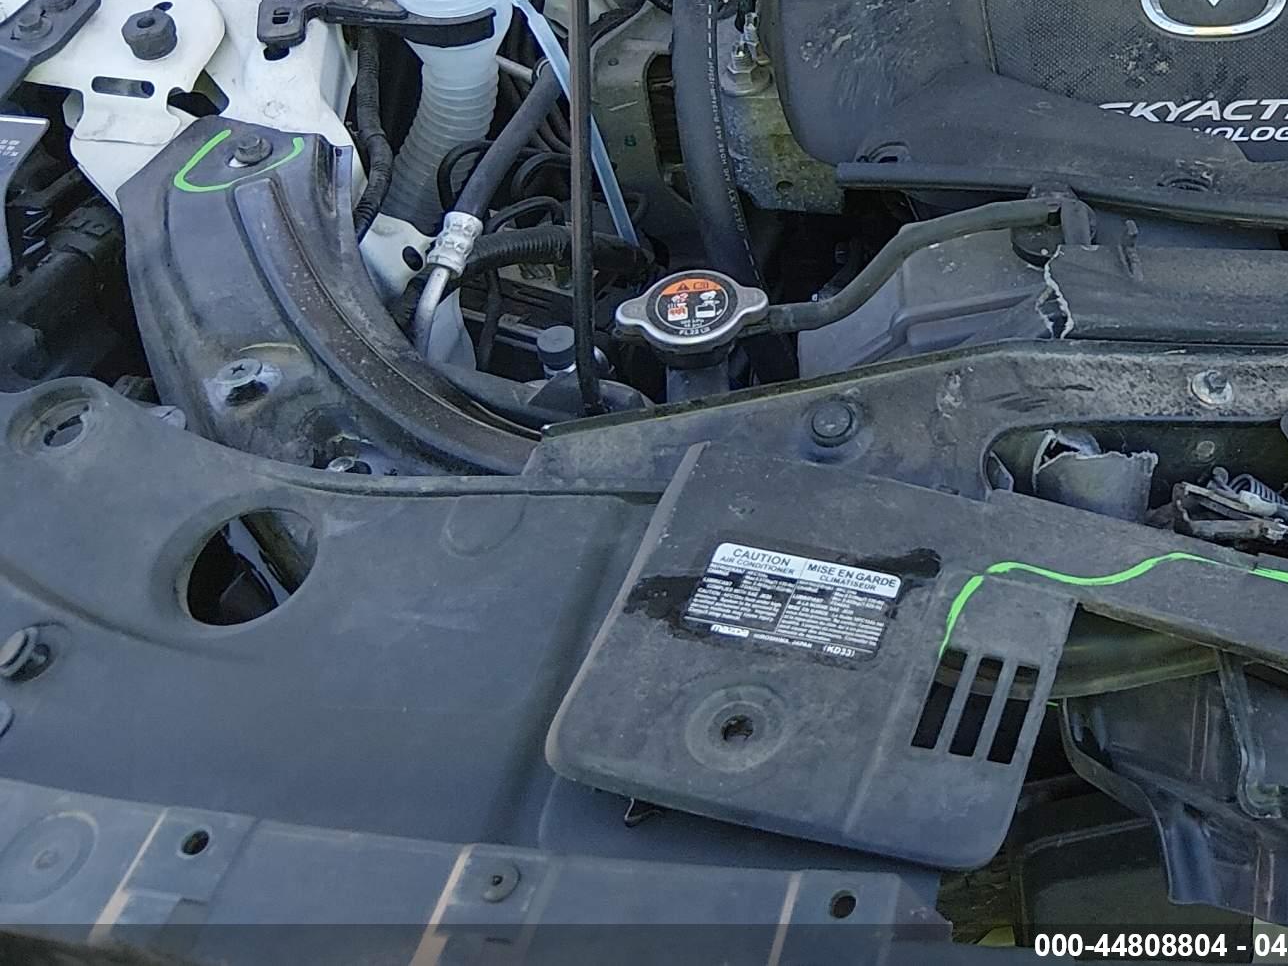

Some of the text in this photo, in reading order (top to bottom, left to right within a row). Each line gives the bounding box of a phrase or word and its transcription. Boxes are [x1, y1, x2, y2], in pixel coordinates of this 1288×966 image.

[720, 555, 735, 563] AIR
[737, 557, 795, 575] CONDITIONER
[733, 548, 791, 566] CAUTION
[808, 563, 897, 588] MISE EN GARDE
[819, 574, 877, 591] CLIMATISEUR
[823, 645, 856, 658] (KD33)
